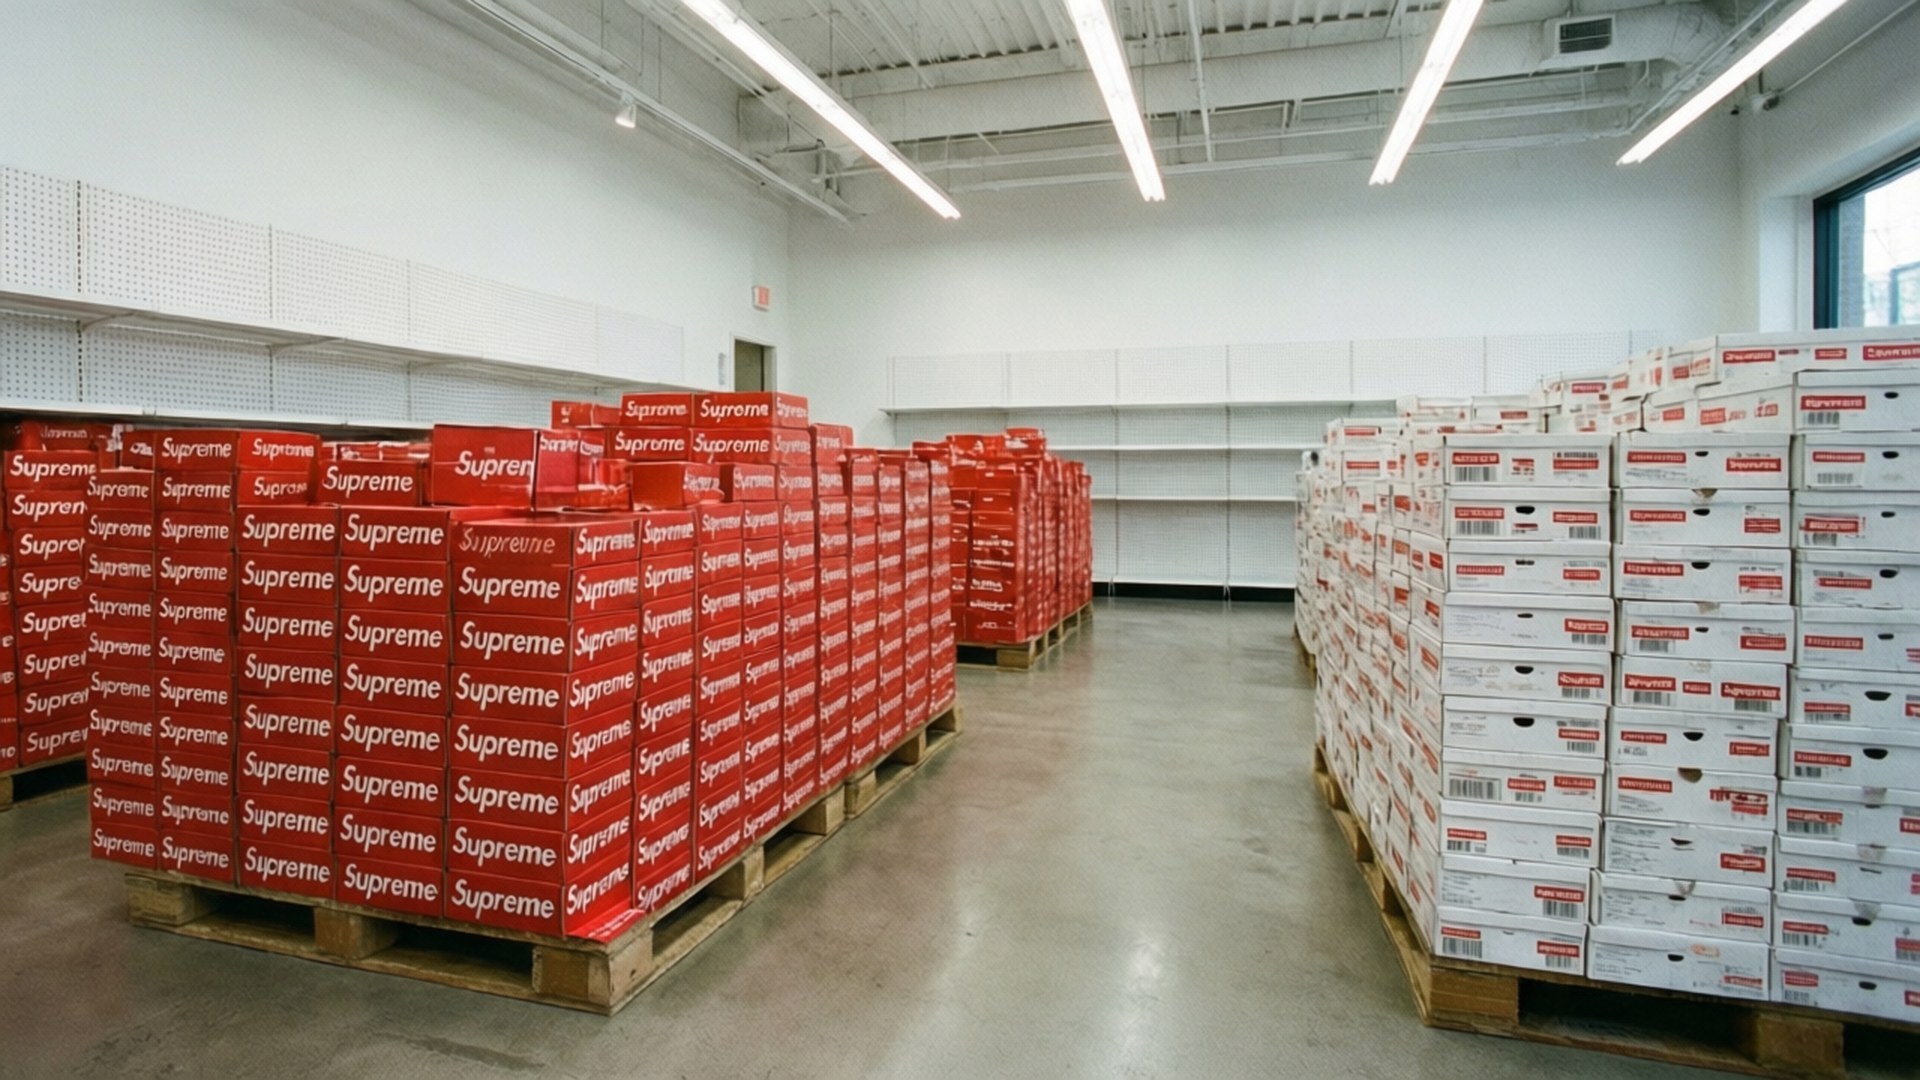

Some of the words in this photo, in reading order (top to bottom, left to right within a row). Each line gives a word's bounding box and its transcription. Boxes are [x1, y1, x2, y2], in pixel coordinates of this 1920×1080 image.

[322, 465, 414, 498] Supreme
[161, 517, 229, 544] Supreme
[242, 514, 336, 548] Supreme
[344, 513, 444, 551] Supreme
[160, 556, 228, 585] Supreme
[241, 560, 335, 595] Supreme
[344, 564, 444, 603] Supreme
[458, 566, 561, 604] Supreme
[159, 597, 228, 625] Supreme
[242, 606, 334, 642] Supreme
[158, 636, 225, 665] Supreme
[344, 614, 443, 652] Supreme
[460, 620, 565, 660] Supreme
[244, 653, 334, 689] Supreme
[343, 663, 442, 702] Supreme
[159, 676, 228, 708] Supreme
[455, 672, 560, 711] Supreme
[159, 716, 229, 746] Supreme
[244, 703, 332, 739] Supreme
[340, 713, 441, 752] Supreme
[454, 724, 559, 762] Supreme
[161, 756, 229, 786] Supreme
[243, 751, 330, 786] Supreme
[341, 764, 439, 804] Supreme
[454, 775, 559, 815] Supreme
[242, 799, 329, 835] Supreme
[340, 813, 437, 853] Supreme
[162, 836, 229, 869] Supreme
[244, 846, 331, 883] Supreme
[452, 826, 557, 867] Supreme
[343, 863, 438, 901] Supreme
[451, 878, 555, 919] Supreme
